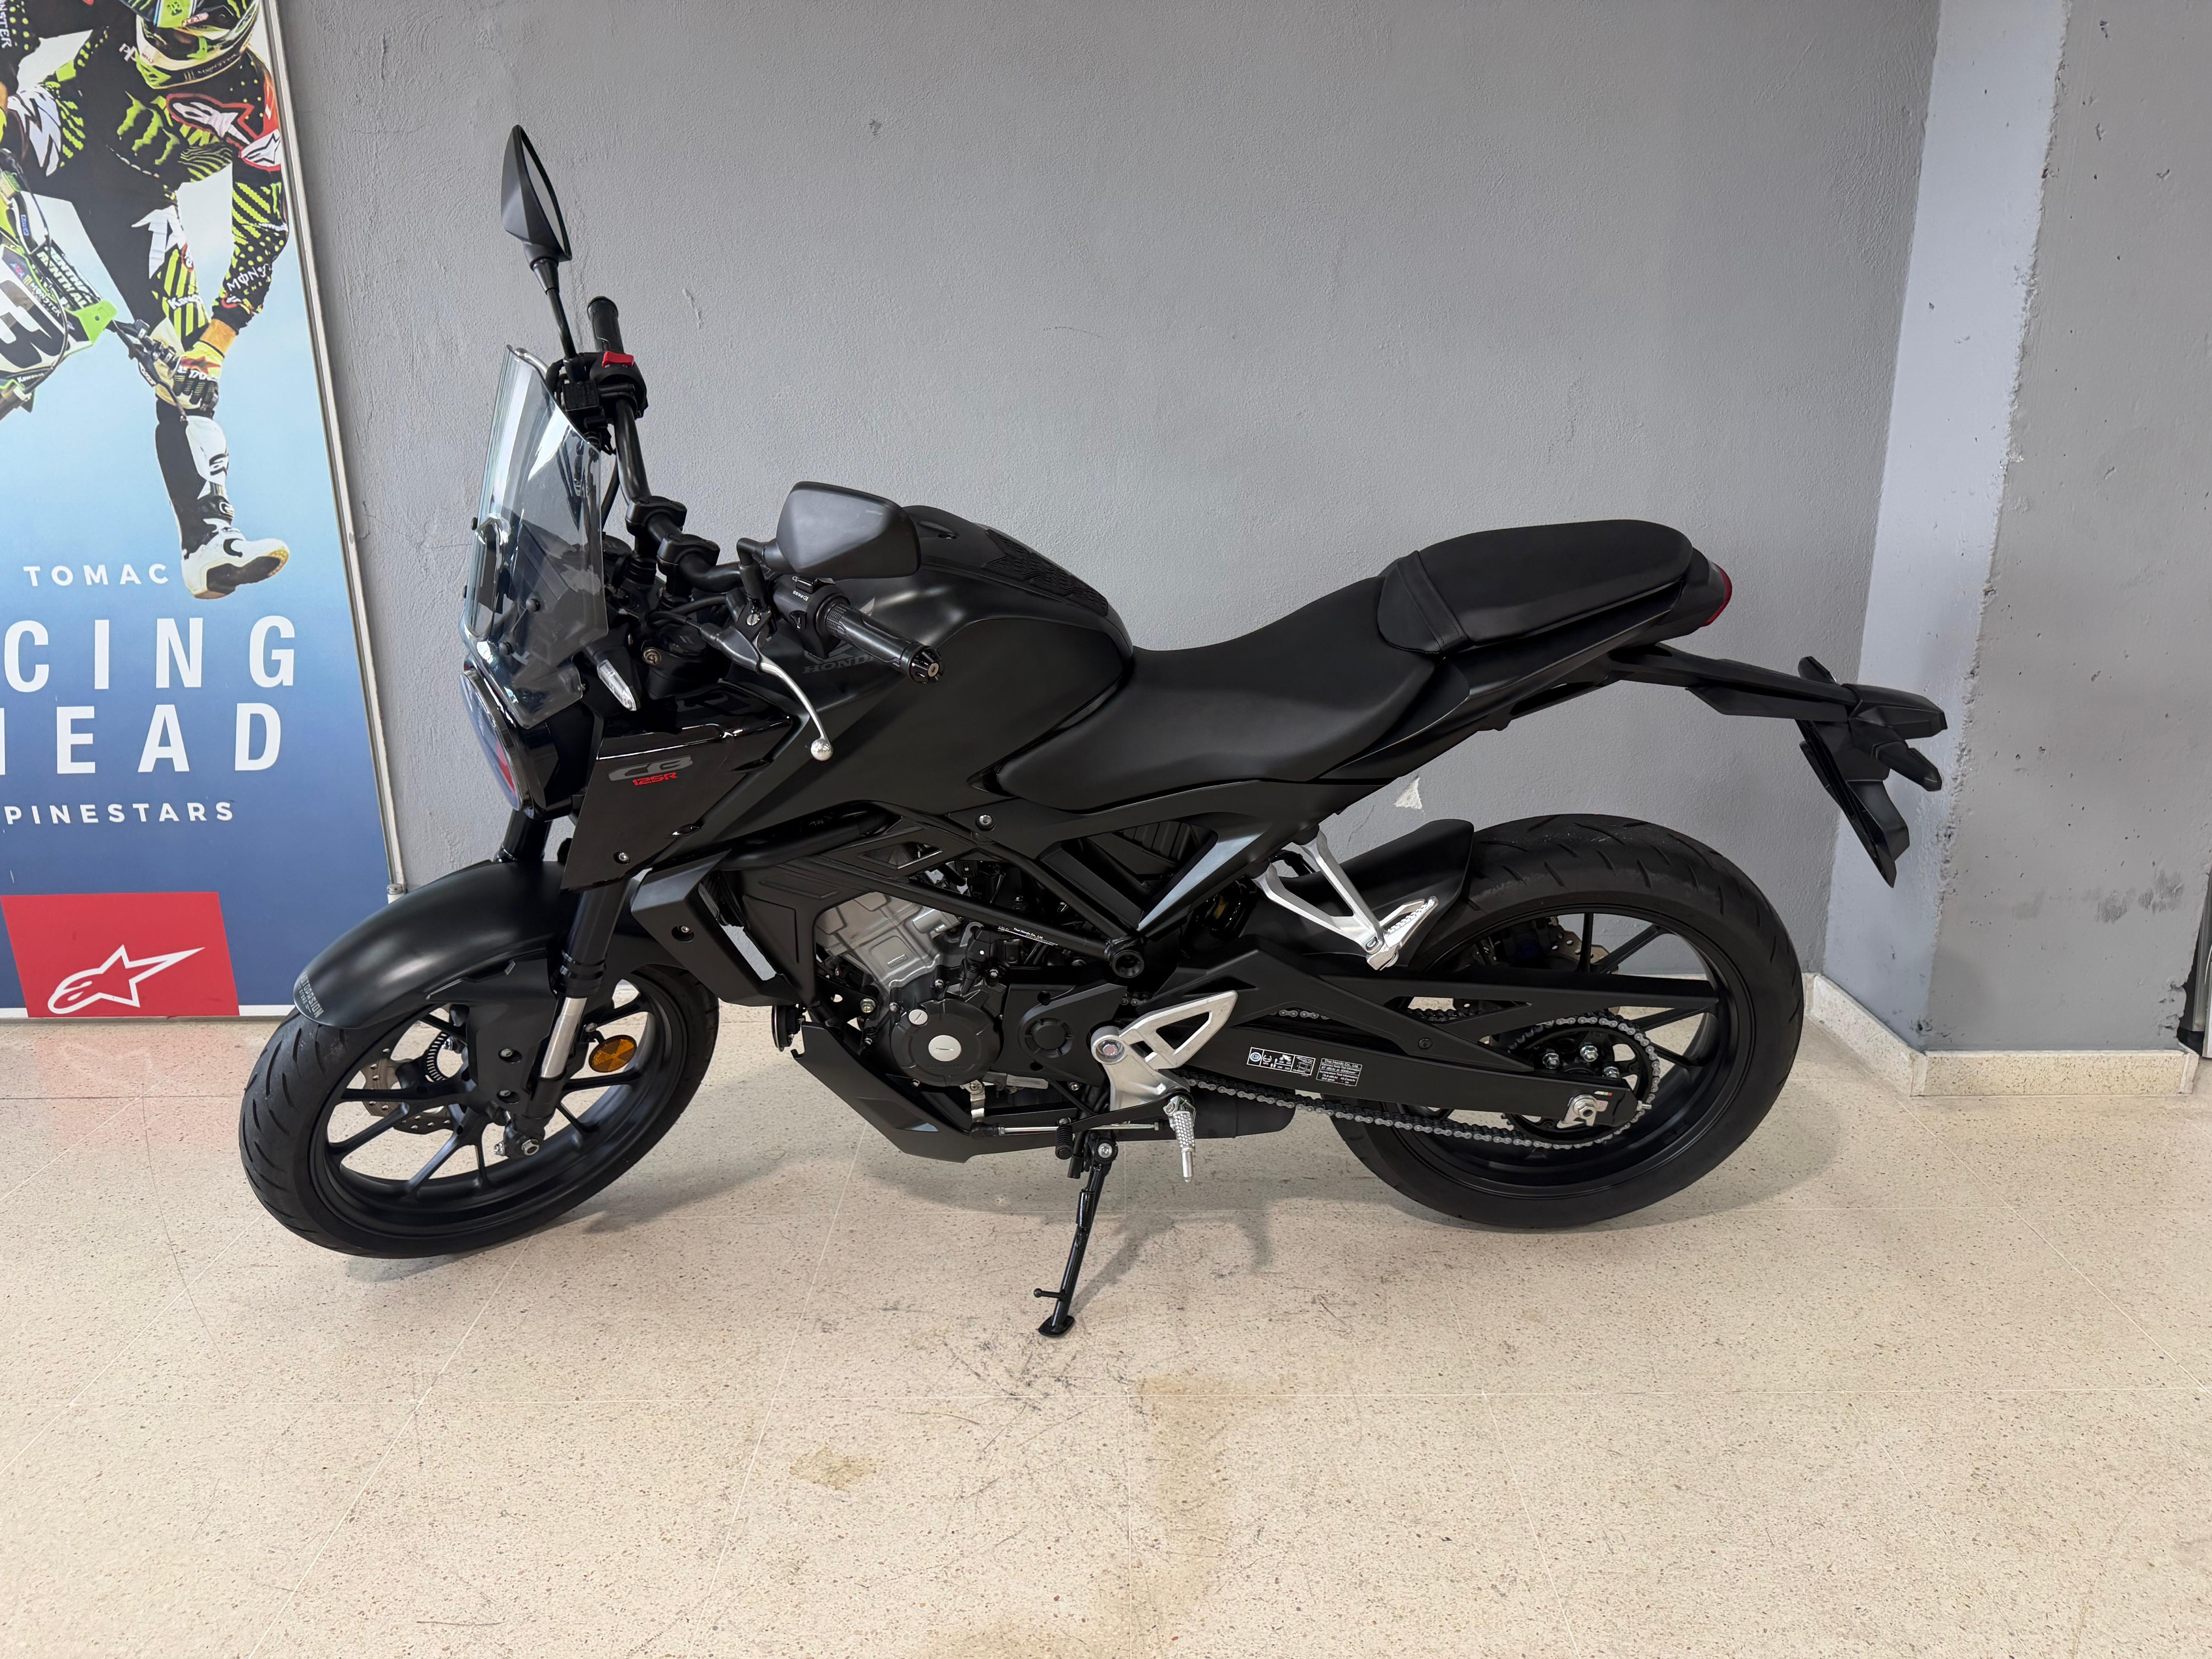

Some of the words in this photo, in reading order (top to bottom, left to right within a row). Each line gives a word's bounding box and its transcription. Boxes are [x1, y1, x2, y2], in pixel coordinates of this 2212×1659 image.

[23, 563, 168, 587] TOMAC
[4, 615, 295, 692] CING
[608, 755, 693, 781] CB
[632, 772, 677, 786] 125R
[4, 802, 233, 825] PINESTARS
